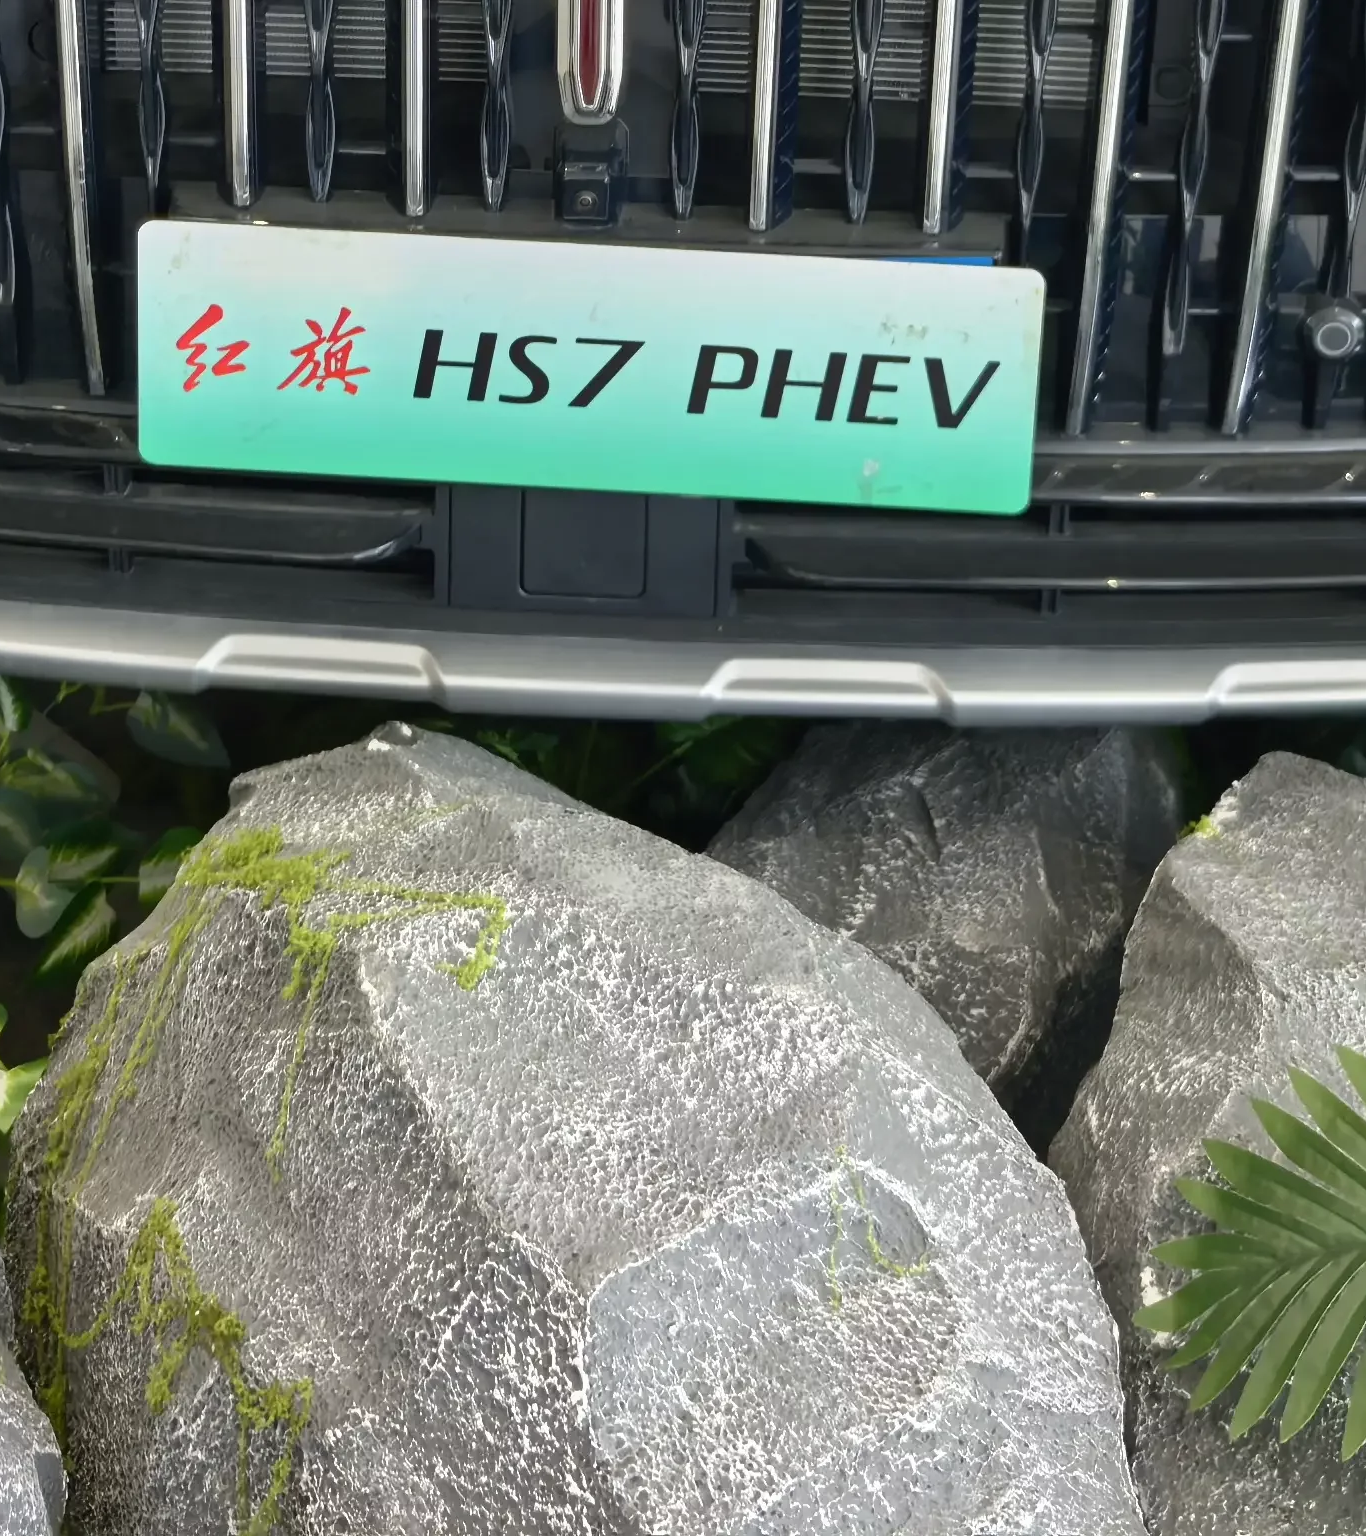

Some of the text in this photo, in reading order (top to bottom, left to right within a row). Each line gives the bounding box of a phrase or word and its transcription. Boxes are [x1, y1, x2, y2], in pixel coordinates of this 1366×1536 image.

[175, 303, 1001, 430] 红旗 HS7 PHEV
